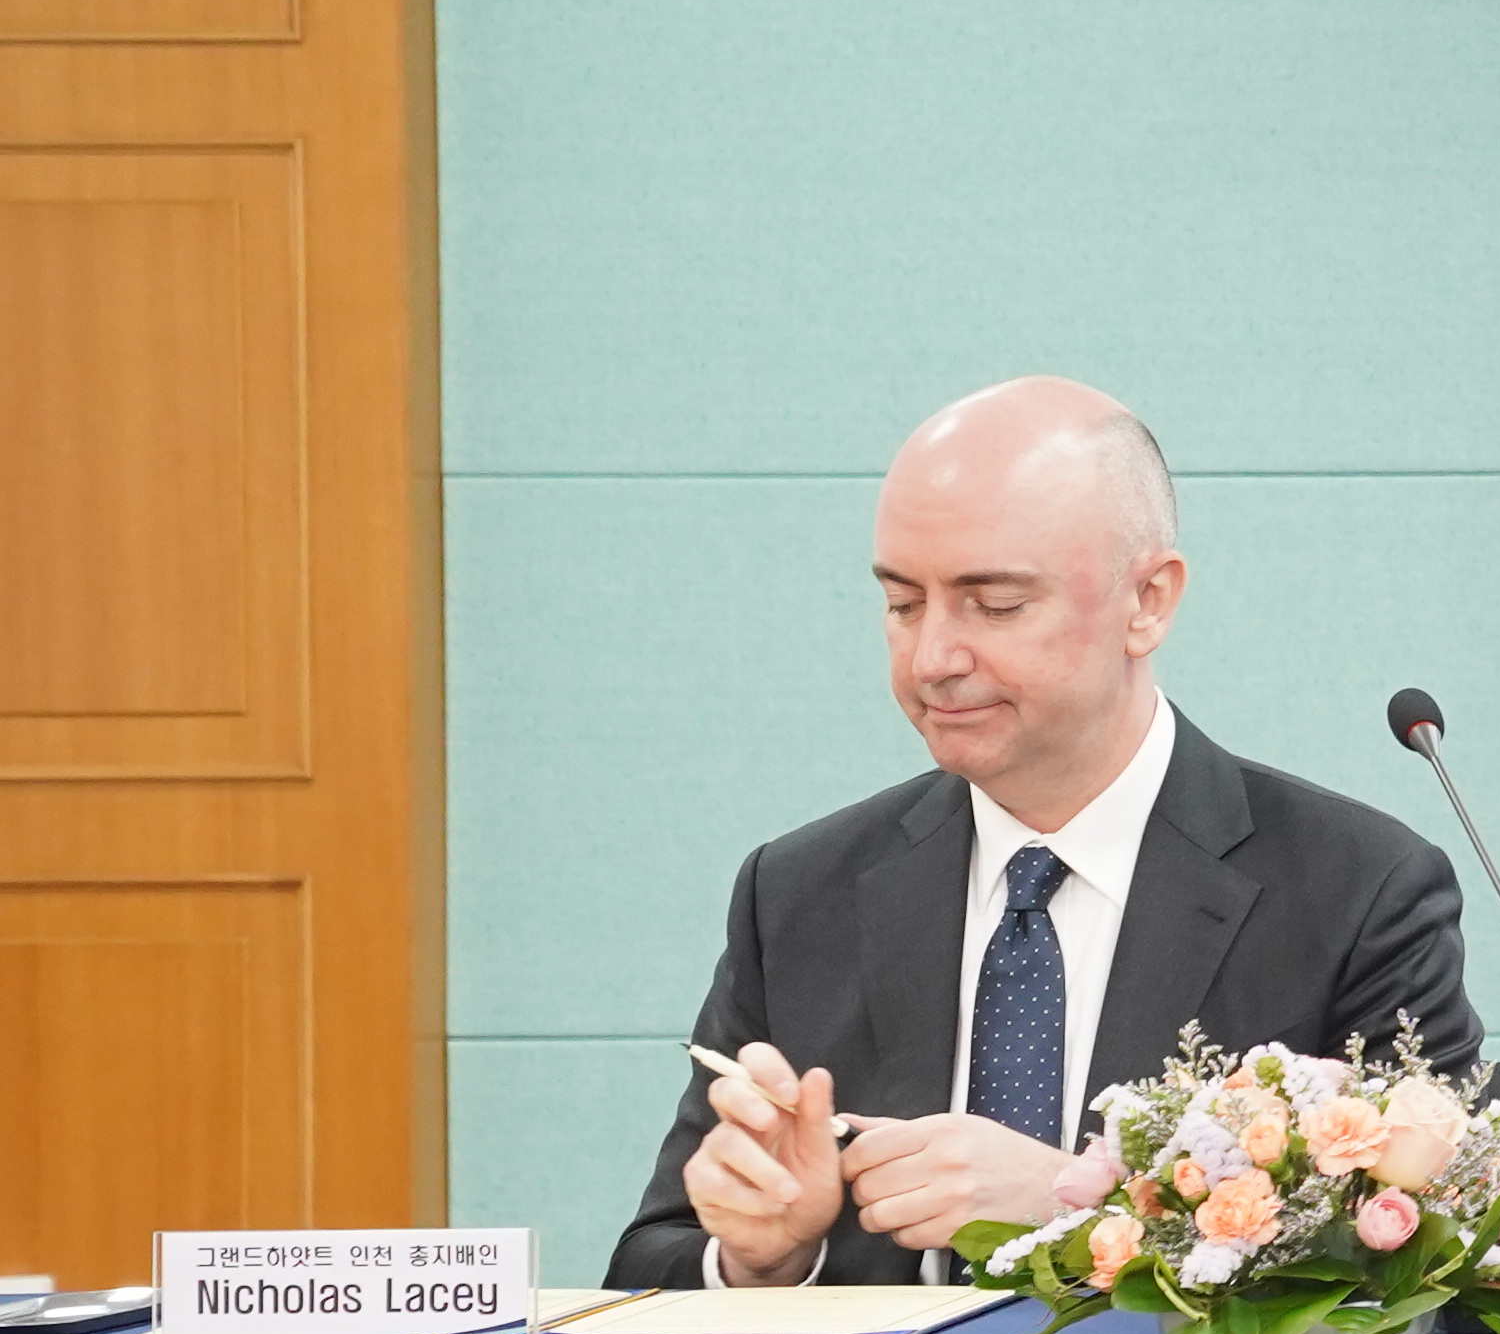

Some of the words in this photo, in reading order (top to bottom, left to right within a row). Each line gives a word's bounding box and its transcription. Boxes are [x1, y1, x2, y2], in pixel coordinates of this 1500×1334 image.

[196, 1246, 334, 1268] 그랜드하얏트
[349, 1245, 393, 1267] 인천
[408, 1244, 499, 1267] 총지배인
[197, 1278, 363, 1315] Nicholas
[386, 1278, 499, 1315] Lacey
